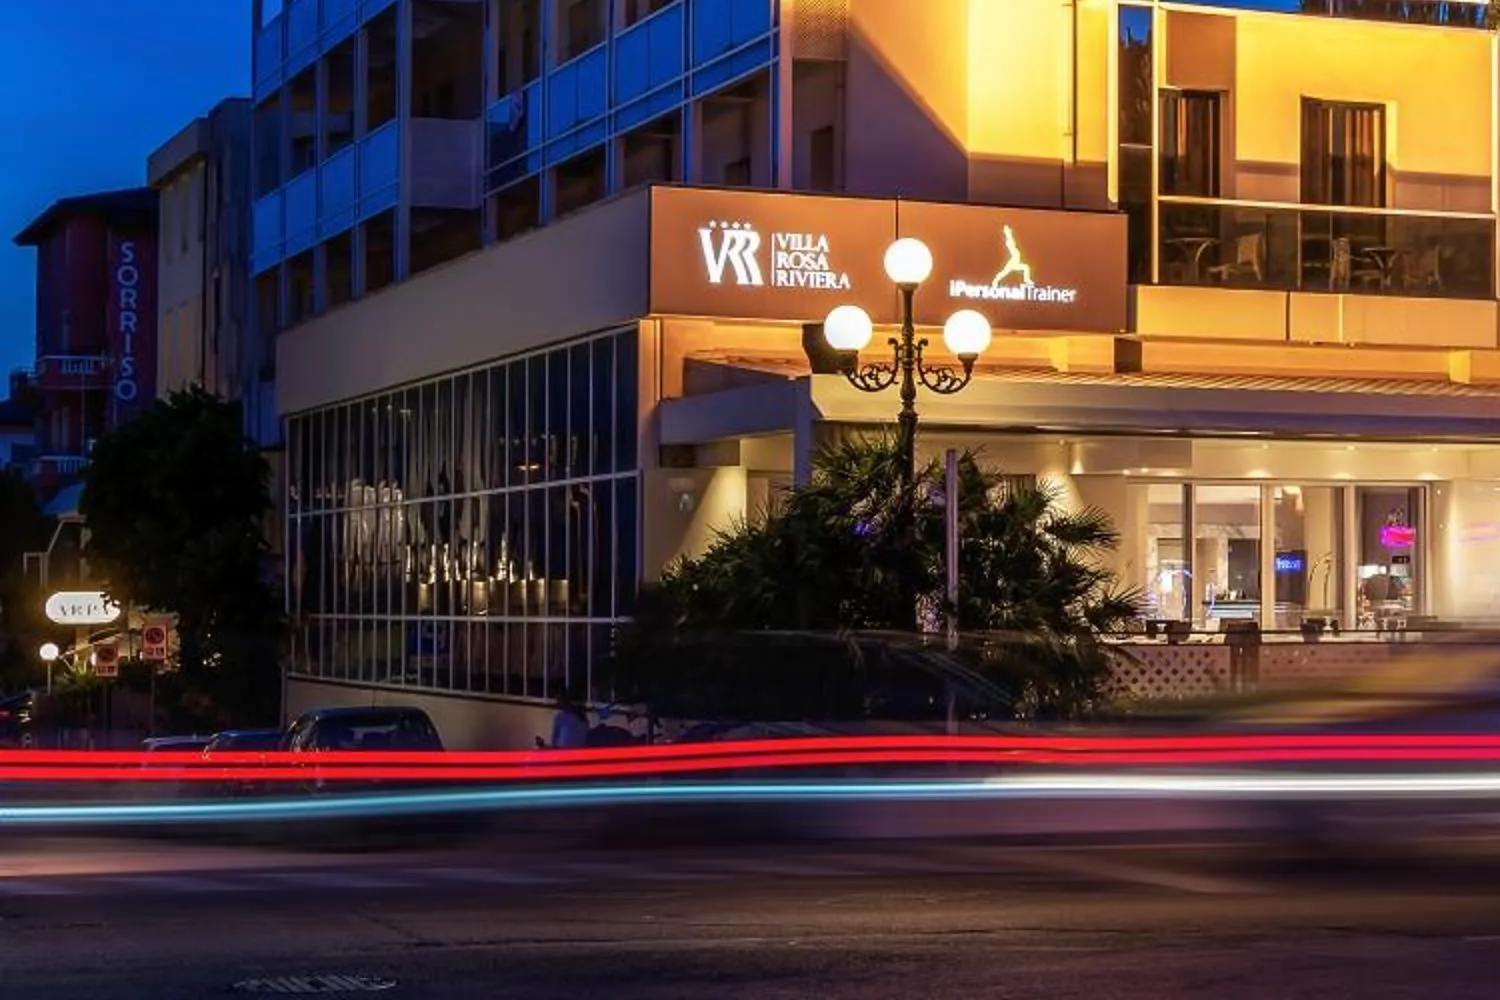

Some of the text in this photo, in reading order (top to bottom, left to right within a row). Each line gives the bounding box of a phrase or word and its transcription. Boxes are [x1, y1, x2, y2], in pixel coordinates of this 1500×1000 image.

[776, 232, 829, 252] VILLA
[776, 252, 829, 270] ROSA
[776, 270, 851, 289] RIVIERA
[116, 241, 138, 400] SORRISO
